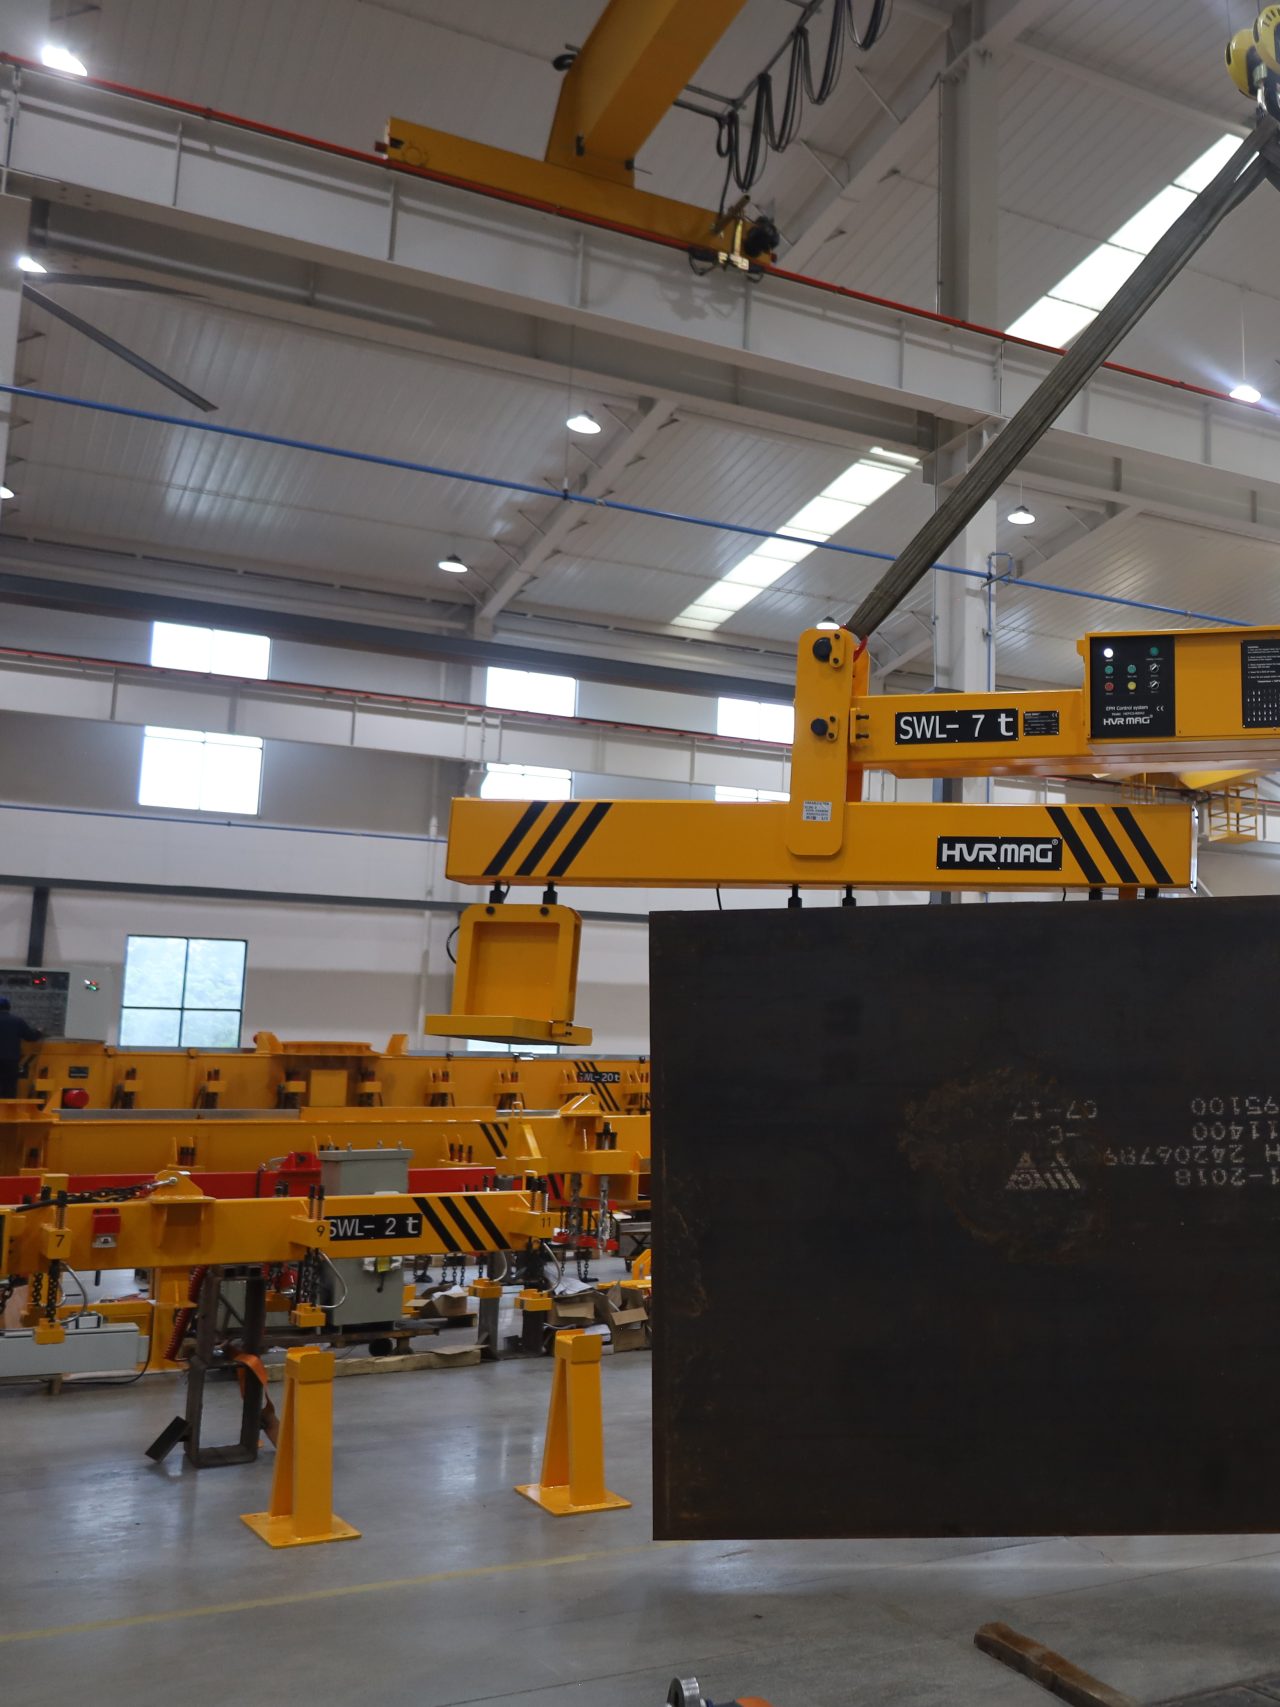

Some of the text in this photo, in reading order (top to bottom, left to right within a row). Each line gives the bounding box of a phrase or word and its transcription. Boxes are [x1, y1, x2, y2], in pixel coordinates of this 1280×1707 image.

[900, 716, 960, 740] SWL-
[972, 714, 985, 738] 7
[997, 713, 1014, 737] t
[1103, 717, 1124, 726] HVR
[941, 843, 1053, 863] HVR MAG
[384, 1217, 397, 1236] 2
[406, 1216, 419, 1235] t
[541, 1216, 551, 1228] 11
[316, 1225, 325, 1237] 9
[55, 1234, 65, 1248] 7
